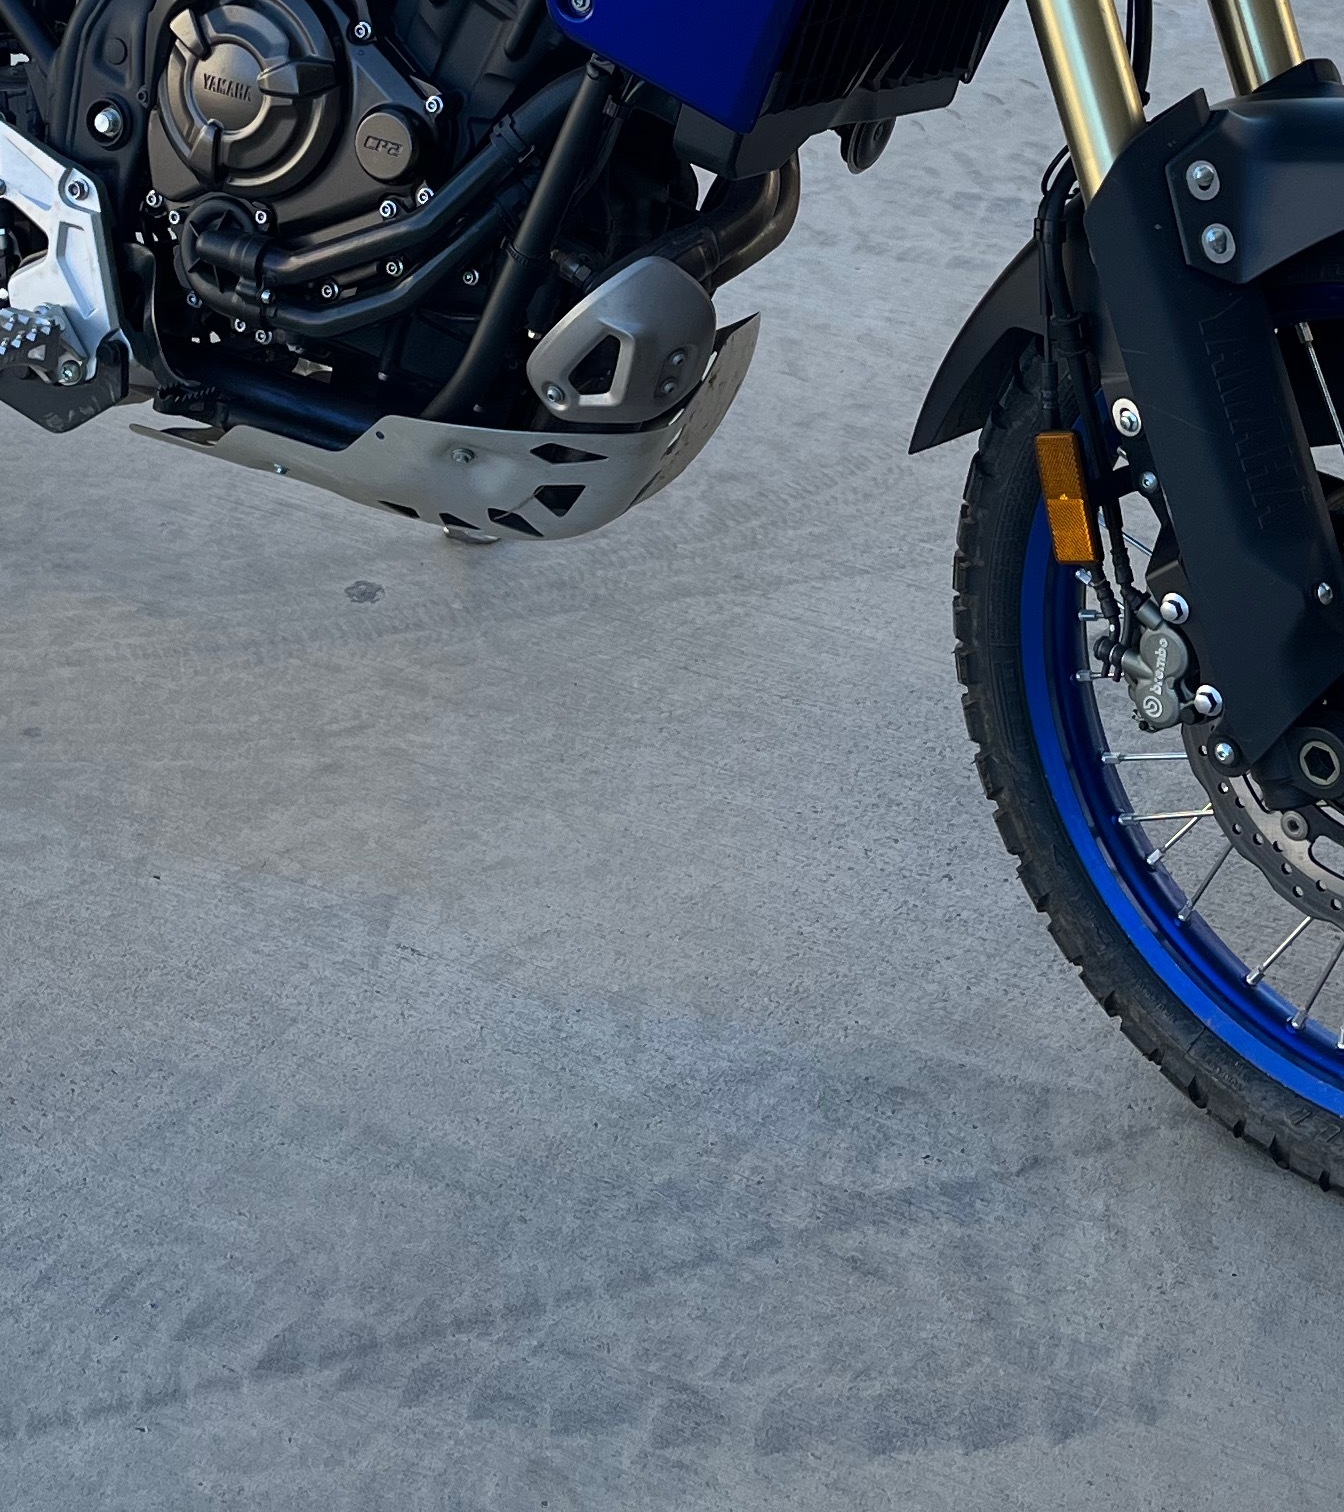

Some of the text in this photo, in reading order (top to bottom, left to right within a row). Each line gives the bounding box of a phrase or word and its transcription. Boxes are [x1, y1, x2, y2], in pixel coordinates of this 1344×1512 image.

[203, 73, 252, 102] YAMAHA
[364, 135, 404, 157] CP2
[1198, 296, 1311, 531] YAMAHA
[1150, 638, 1168, 695] brembo
